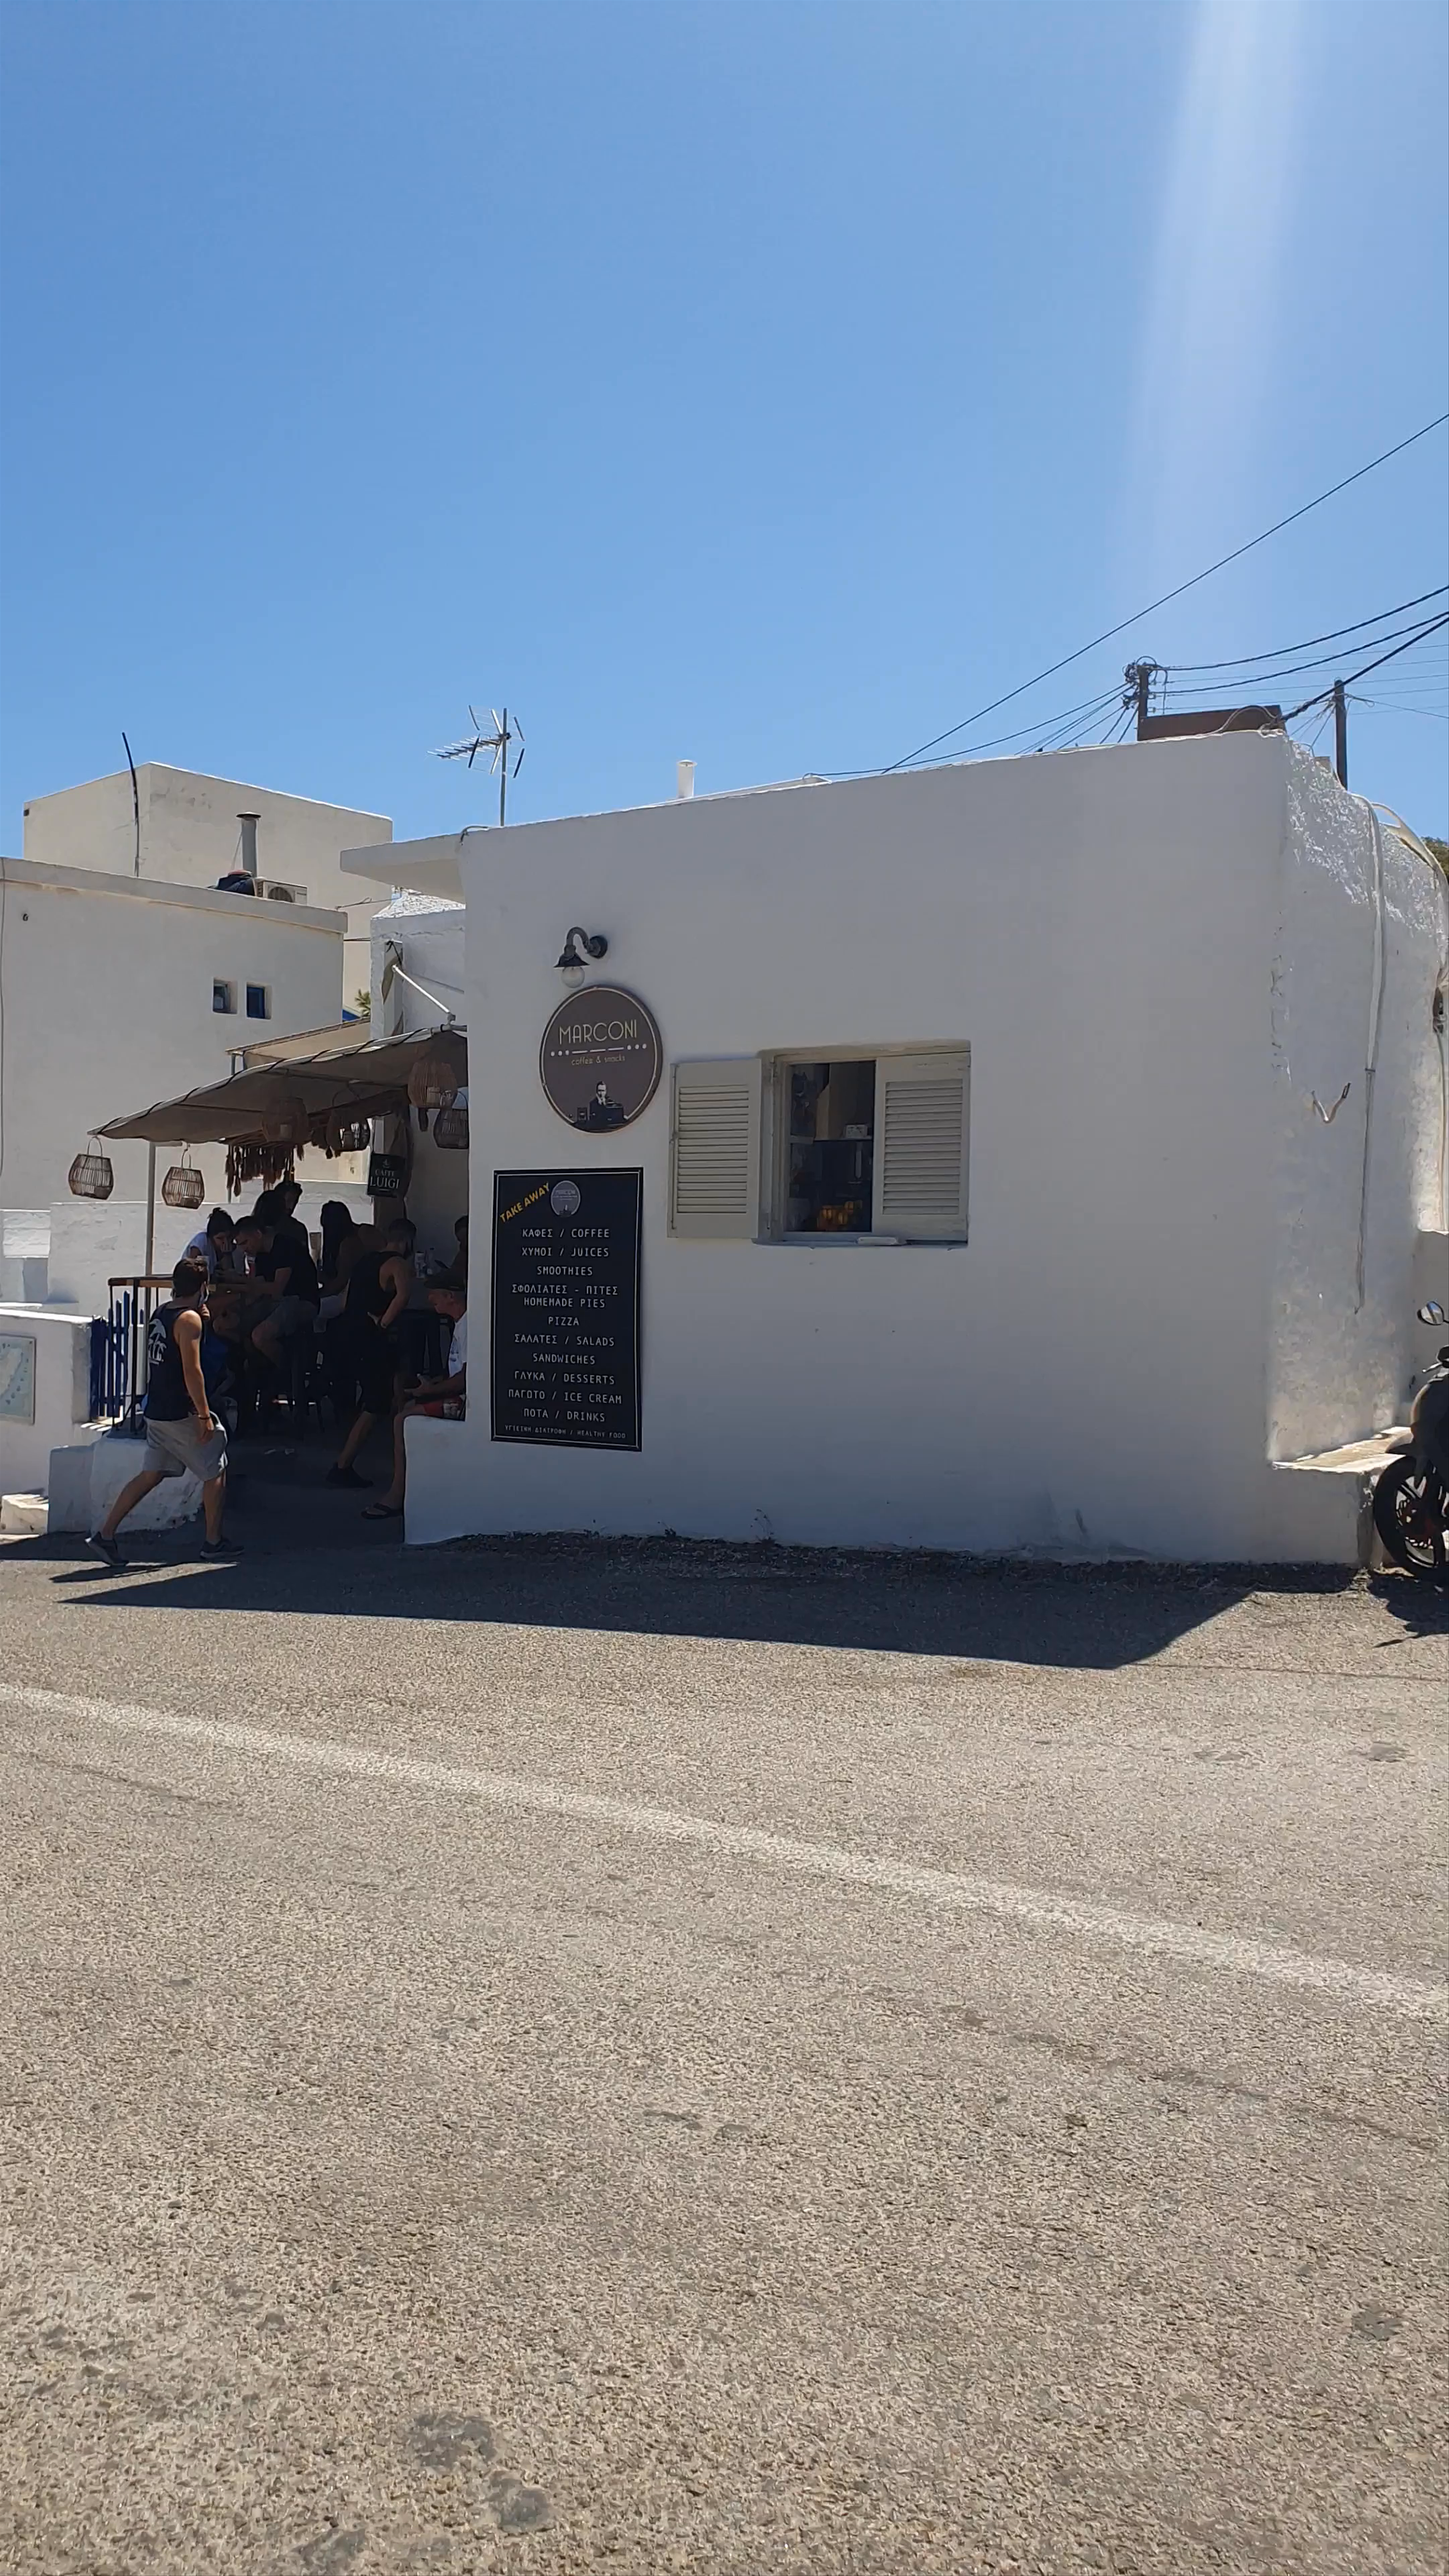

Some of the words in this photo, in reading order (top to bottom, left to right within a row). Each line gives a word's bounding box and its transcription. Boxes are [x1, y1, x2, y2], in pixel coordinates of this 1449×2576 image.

[559, 1020, 637, 1045] MARCONI
[370, 1176, 400, 1189] LUIGI
[500, 1202, 523, 1223] TAKE
[524, 1183, 550, 1207] AWAY
[522, 1229, 552, 1237] ΚΑΦΕΣ
[571, 1229, 609, 1238] COFFEE
[522, 1247, 552, 1256] ΧΥΜΟΙ
[571, 1247, 609, 1257] JUICES
[537, 1266, 592, 1276] SMOOTHIES
[512, 1284, 567, 1294] ΣΦΟΛΙΑΤΕΣ
[586, 1286, 618, 1295] ΠΙΤΕΣ
[524, 1297, 573, 1307] HOMEMADE
[580, 1298, 605, 1308] PIES
[548, 1316, 579, 1326] PIZZA
[515, 1334, 557, 1344] ΣΑΛΑΤΕΣ
[577, 1336, 614, 1346] SALADS
[533, 1353, 595, 1365] SANDWICHES
[515, 1371, 545, 1381] ΓΛΥΚΑ
[564, 1373, 614, 1385] DESSERTS
[509, 1389, 545, 1399] ΠΑΓΩΤΟ
[565, 1392, 582, 1402] ICE
[589, 1393, 621, 1404] CREAM
[524, 1408, 548, 1418] ΠΟΤΑ
[567, 1411, 605, 1422] DRINKS
